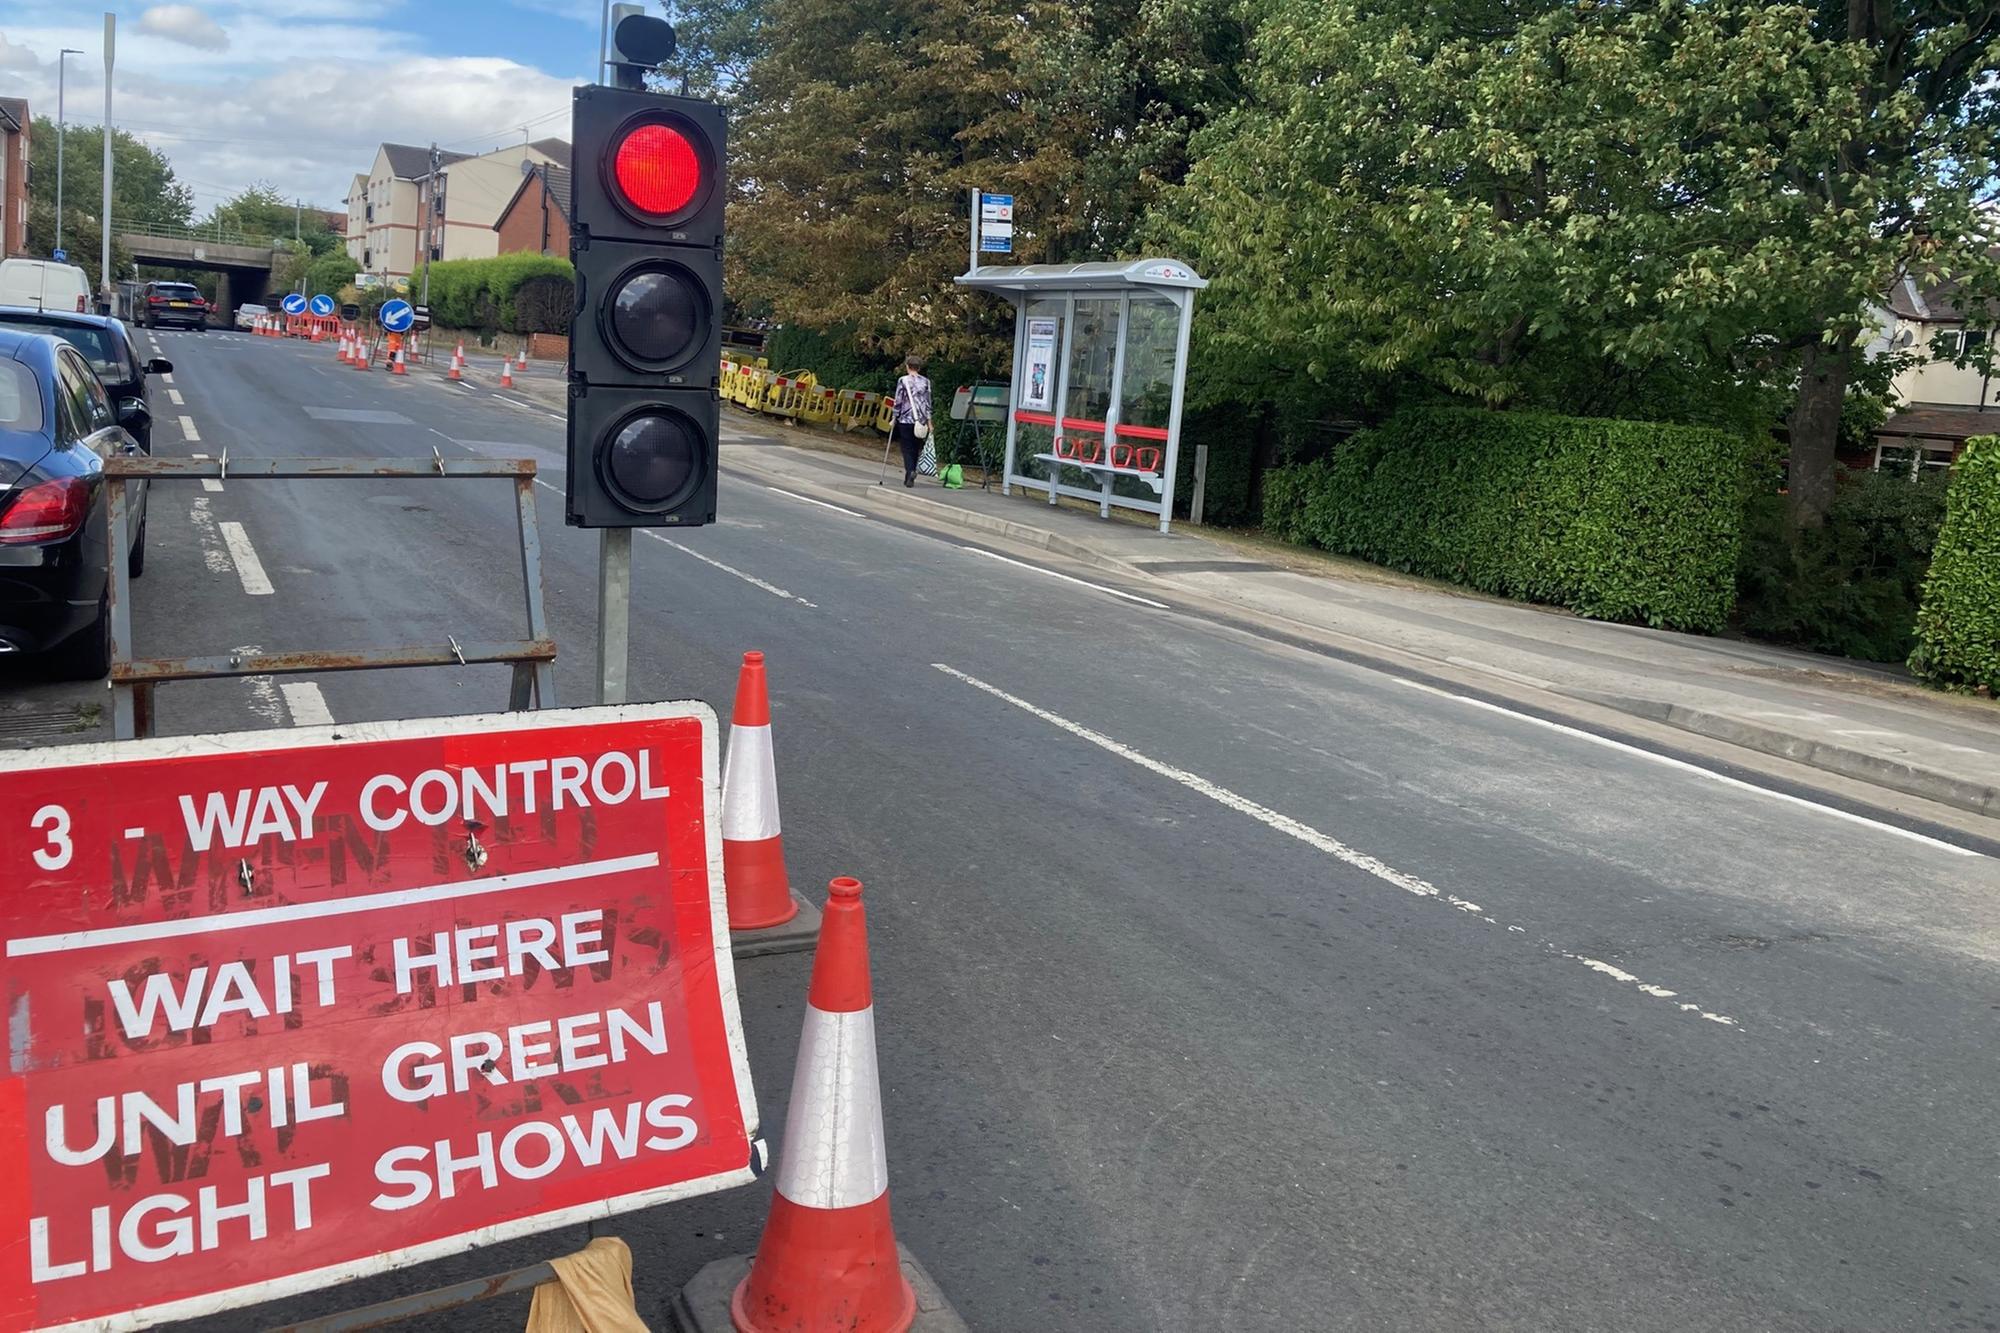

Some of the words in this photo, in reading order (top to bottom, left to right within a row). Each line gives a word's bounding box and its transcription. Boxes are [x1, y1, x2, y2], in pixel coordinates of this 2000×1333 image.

[30, 804, 73, 871] 3
[178, 781, 329, 852] WAY
[359, 749, 670, 832] CONTROL
[107, 944, 353, 1039] WAIT
[392, 908, 610, 995] HERE
[45, 1061, 345, 1166] UNTIL
[381, 1000, 669, 1103] GREEN
[29, 1162, 331, 1284] LIGHT
[369, 1093, 698, 1211] SHOWS
